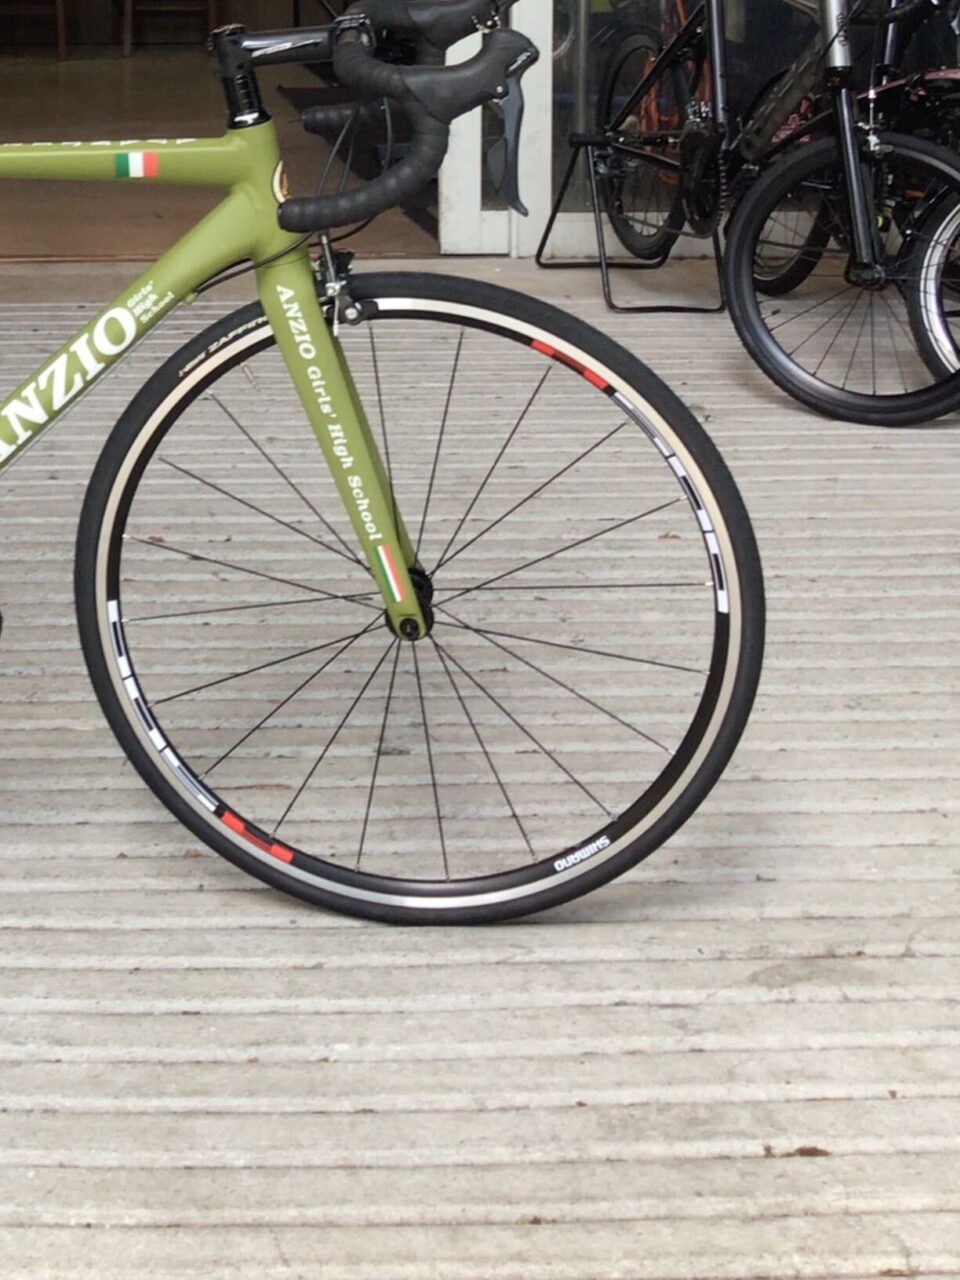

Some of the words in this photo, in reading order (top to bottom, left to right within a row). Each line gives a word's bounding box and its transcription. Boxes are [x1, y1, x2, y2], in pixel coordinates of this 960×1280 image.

[276, 284, 317, 360] ANZIO
[306, 365, 338, 419] Girls'
[328, 423, 354, 470] High
[347, 475, 383, 542] School
[553, 834, 612, 873] SHIMANO
